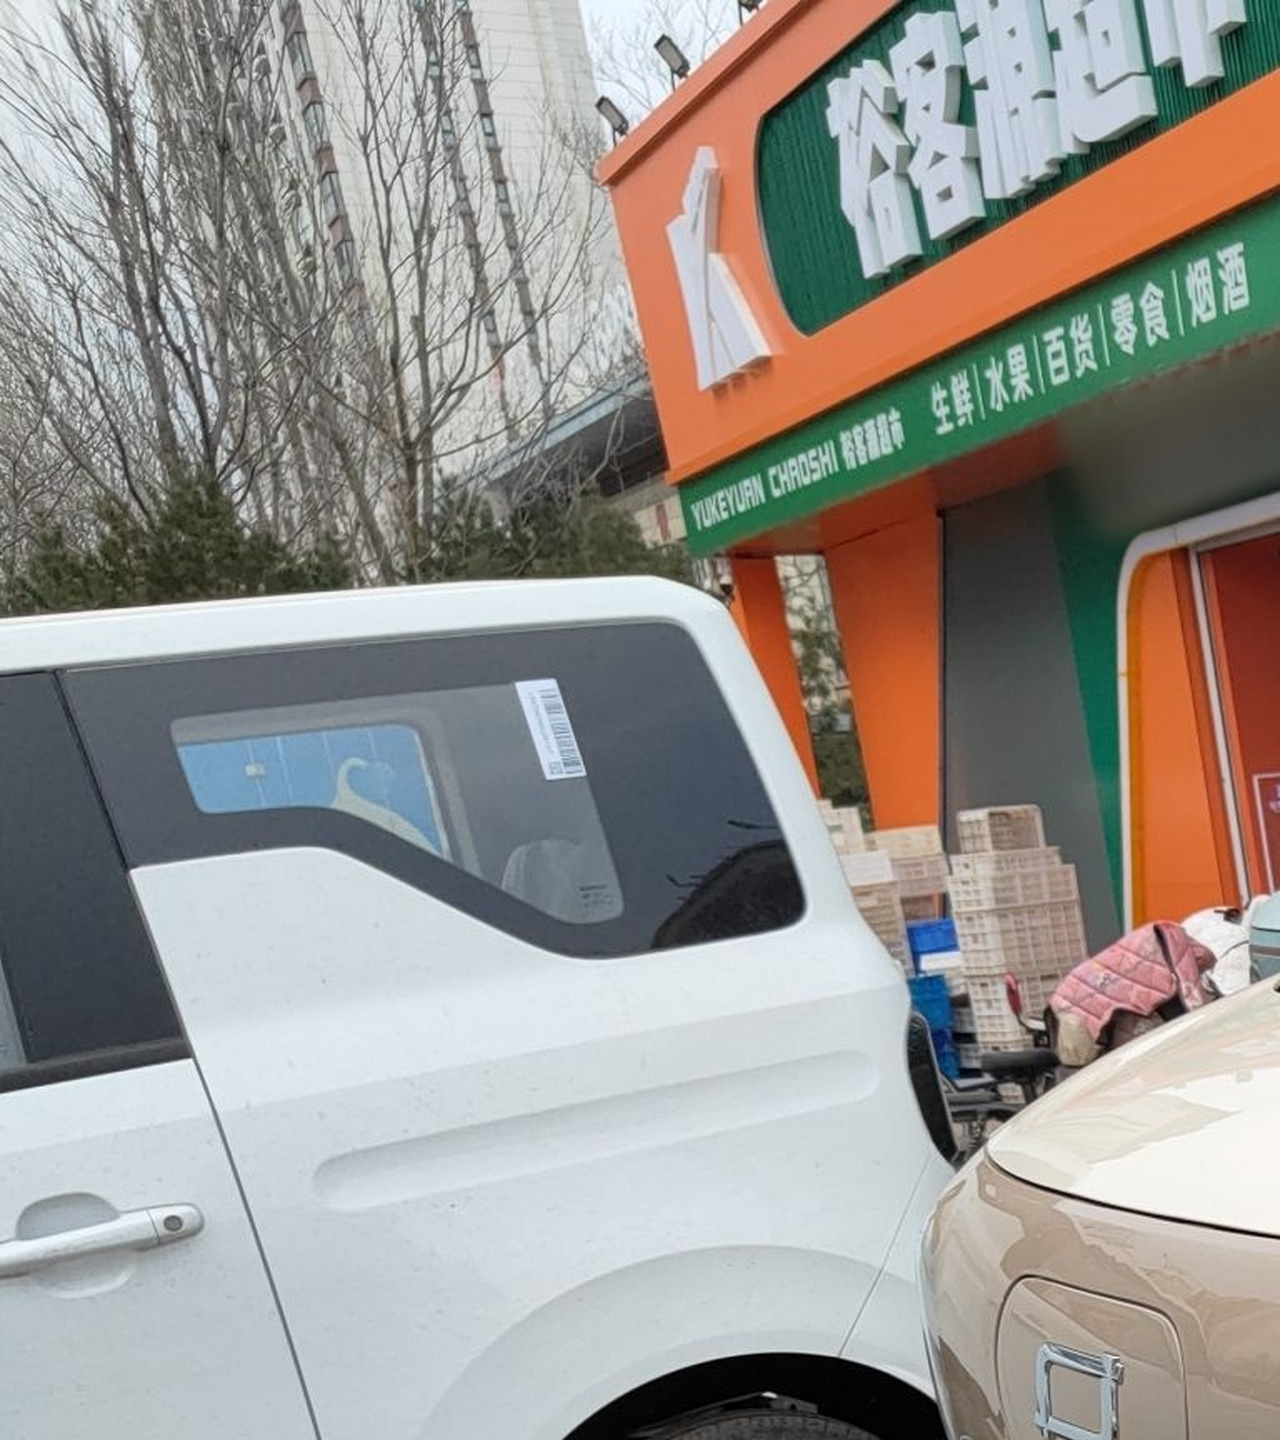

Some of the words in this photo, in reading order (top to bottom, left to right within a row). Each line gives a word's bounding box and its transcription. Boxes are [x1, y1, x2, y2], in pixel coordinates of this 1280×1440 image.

[985, 343, 1034, 413] 水果
[1042, 312, 1098, 386] 百货
[1111, 280, 1170, 355] 零食
[1185, 241, 1250, 328] 烟酒
[691, 473, 766, 531] YUKEYUAN
[768, 440, 839, 499] CHAOSHI
